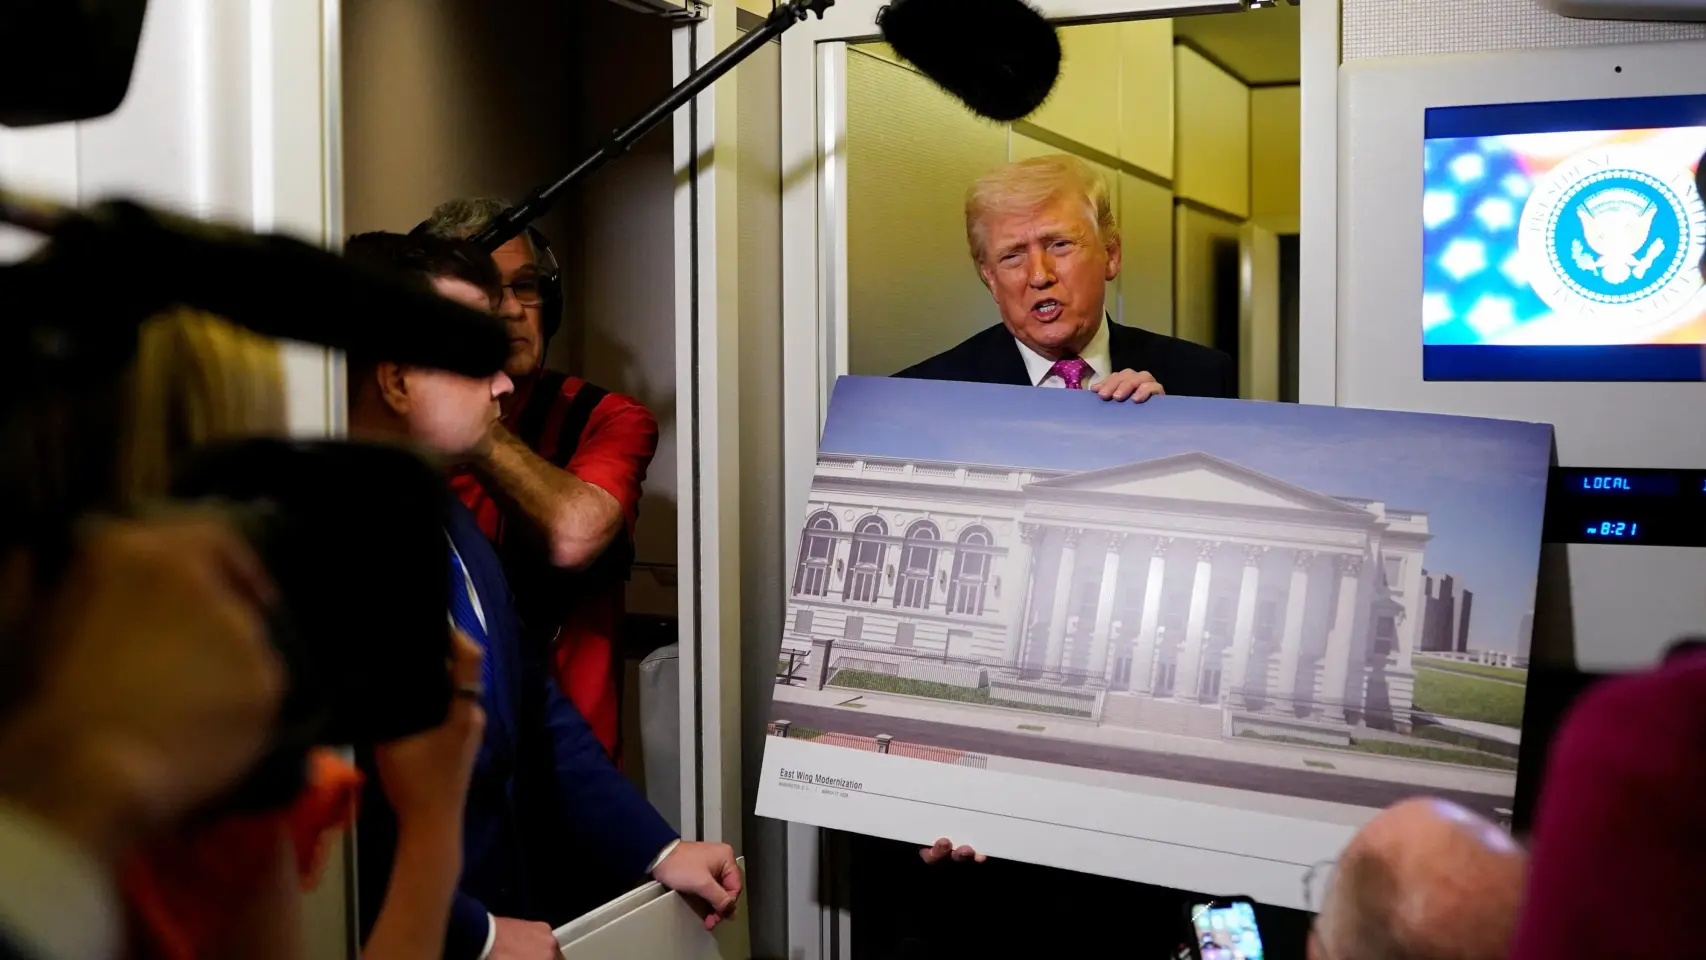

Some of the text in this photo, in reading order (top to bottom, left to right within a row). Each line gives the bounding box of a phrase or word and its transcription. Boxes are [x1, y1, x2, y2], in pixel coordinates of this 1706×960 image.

[1583, 476, 1631, 490] LOCAL
[1600, 521, 1637, 536] 8:21
[780, 768, 795, 779] East
[796, 771, 813, 783] Wing
[815, 774, 863, 790] Modernization
